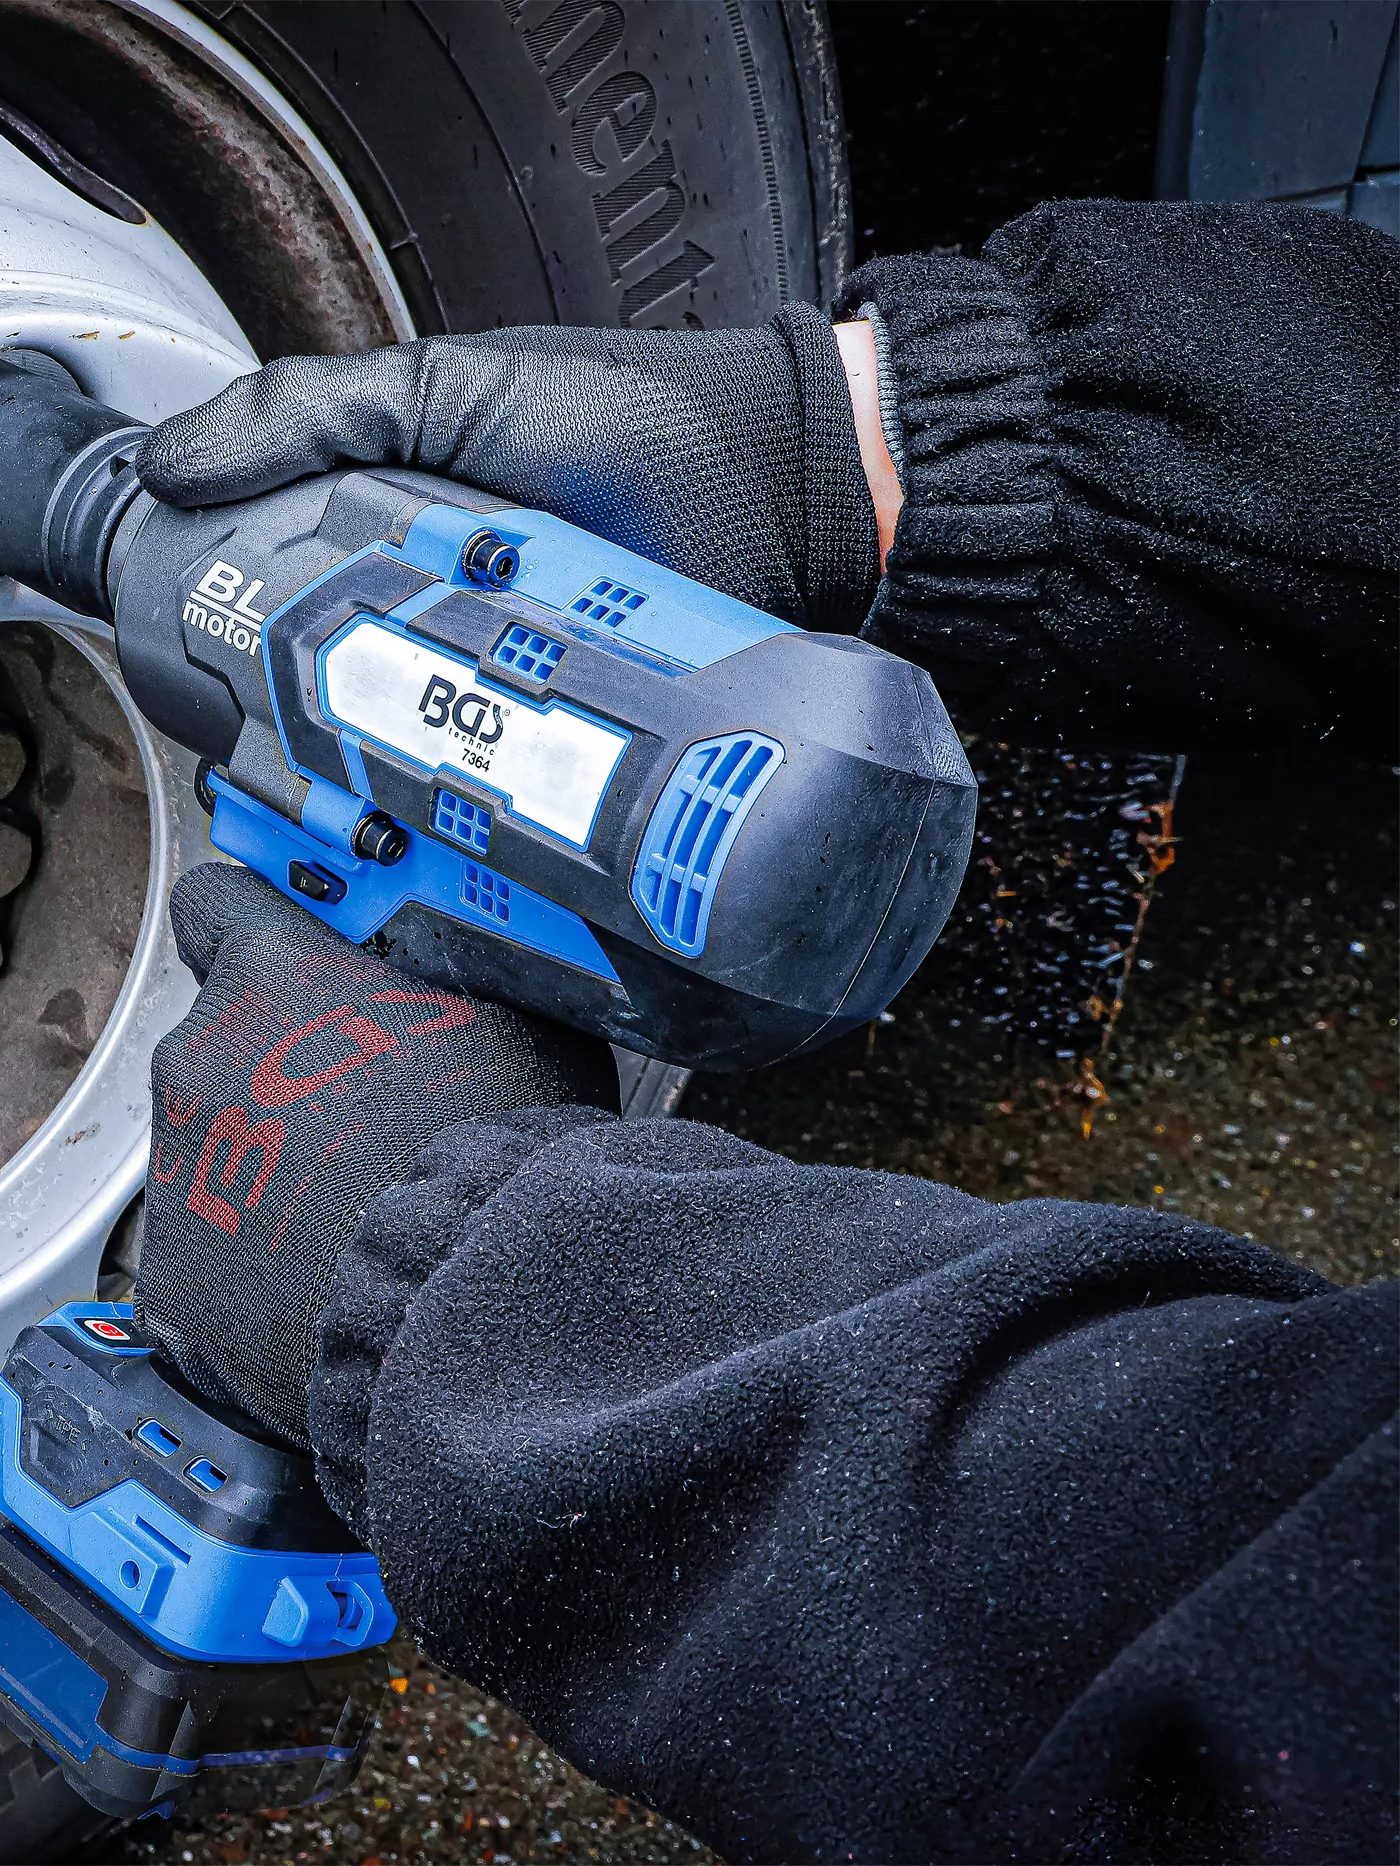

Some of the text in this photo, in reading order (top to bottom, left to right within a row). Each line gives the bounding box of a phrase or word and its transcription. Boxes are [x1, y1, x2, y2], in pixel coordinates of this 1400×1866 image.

[195, 559, 266, 623] BL
[182, 599, 262, 657] motor
[418, 674, 503, 744] BGS
[448, 726, 496, 756] technic
[461, 746, 492, 772] 7364
